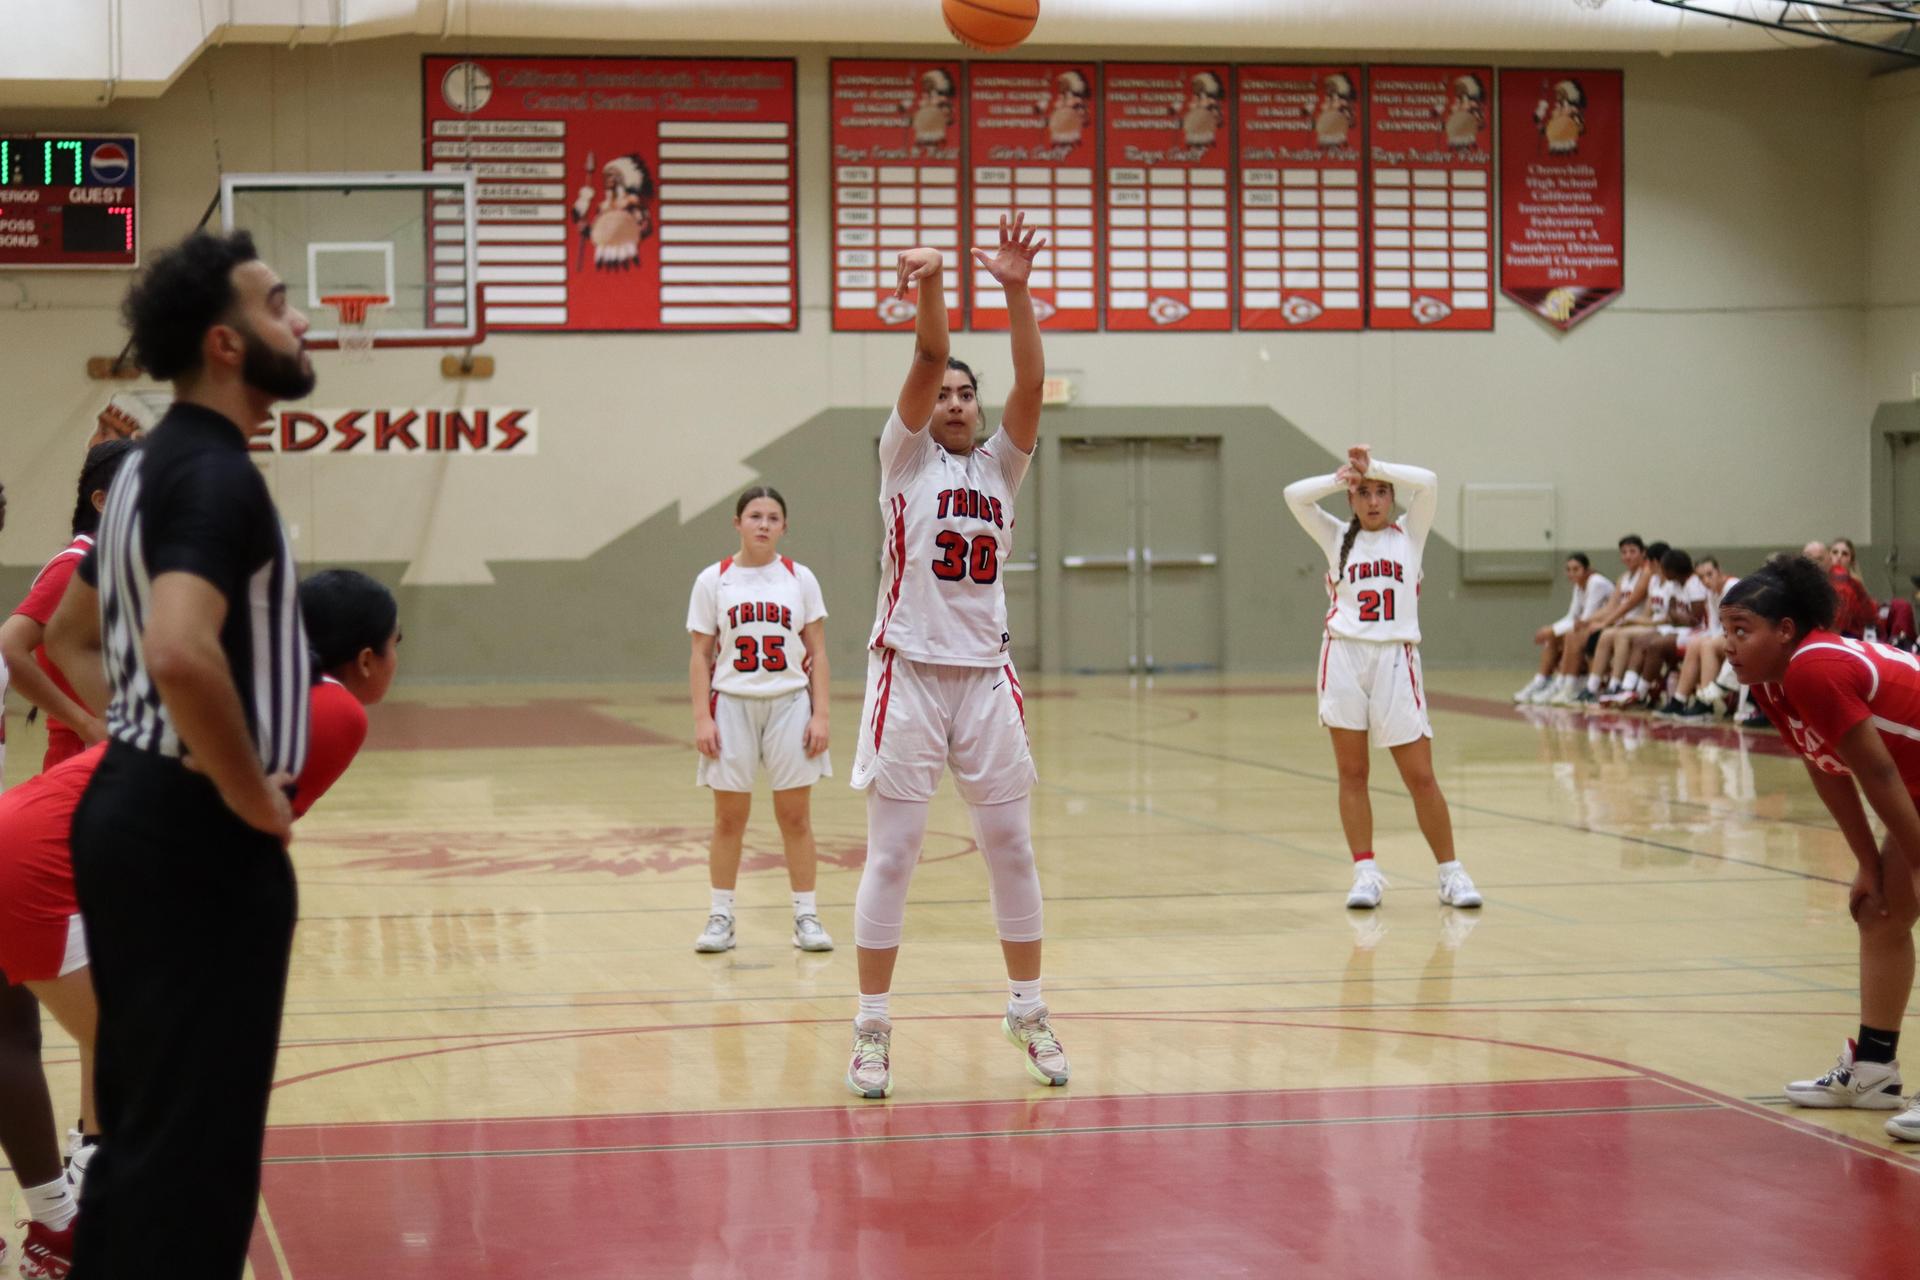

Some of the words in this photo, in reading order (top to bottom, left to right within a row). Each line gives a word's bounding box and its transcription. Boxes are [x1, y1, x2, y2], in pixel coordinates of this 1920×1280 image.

[69, 187, 125, 203] GUEST
[248, 409, 530, 452] EDSKINS
[937, 488, 1004, 530] TRIBE
[932, 529, 998, 584] 30
[1348, 558, 1404, 584] TRIBE
[727, 601, 792, 631] TRIBE
[1357, 588, 1395, 621] 21
[733, 635, 788, 672] 35
